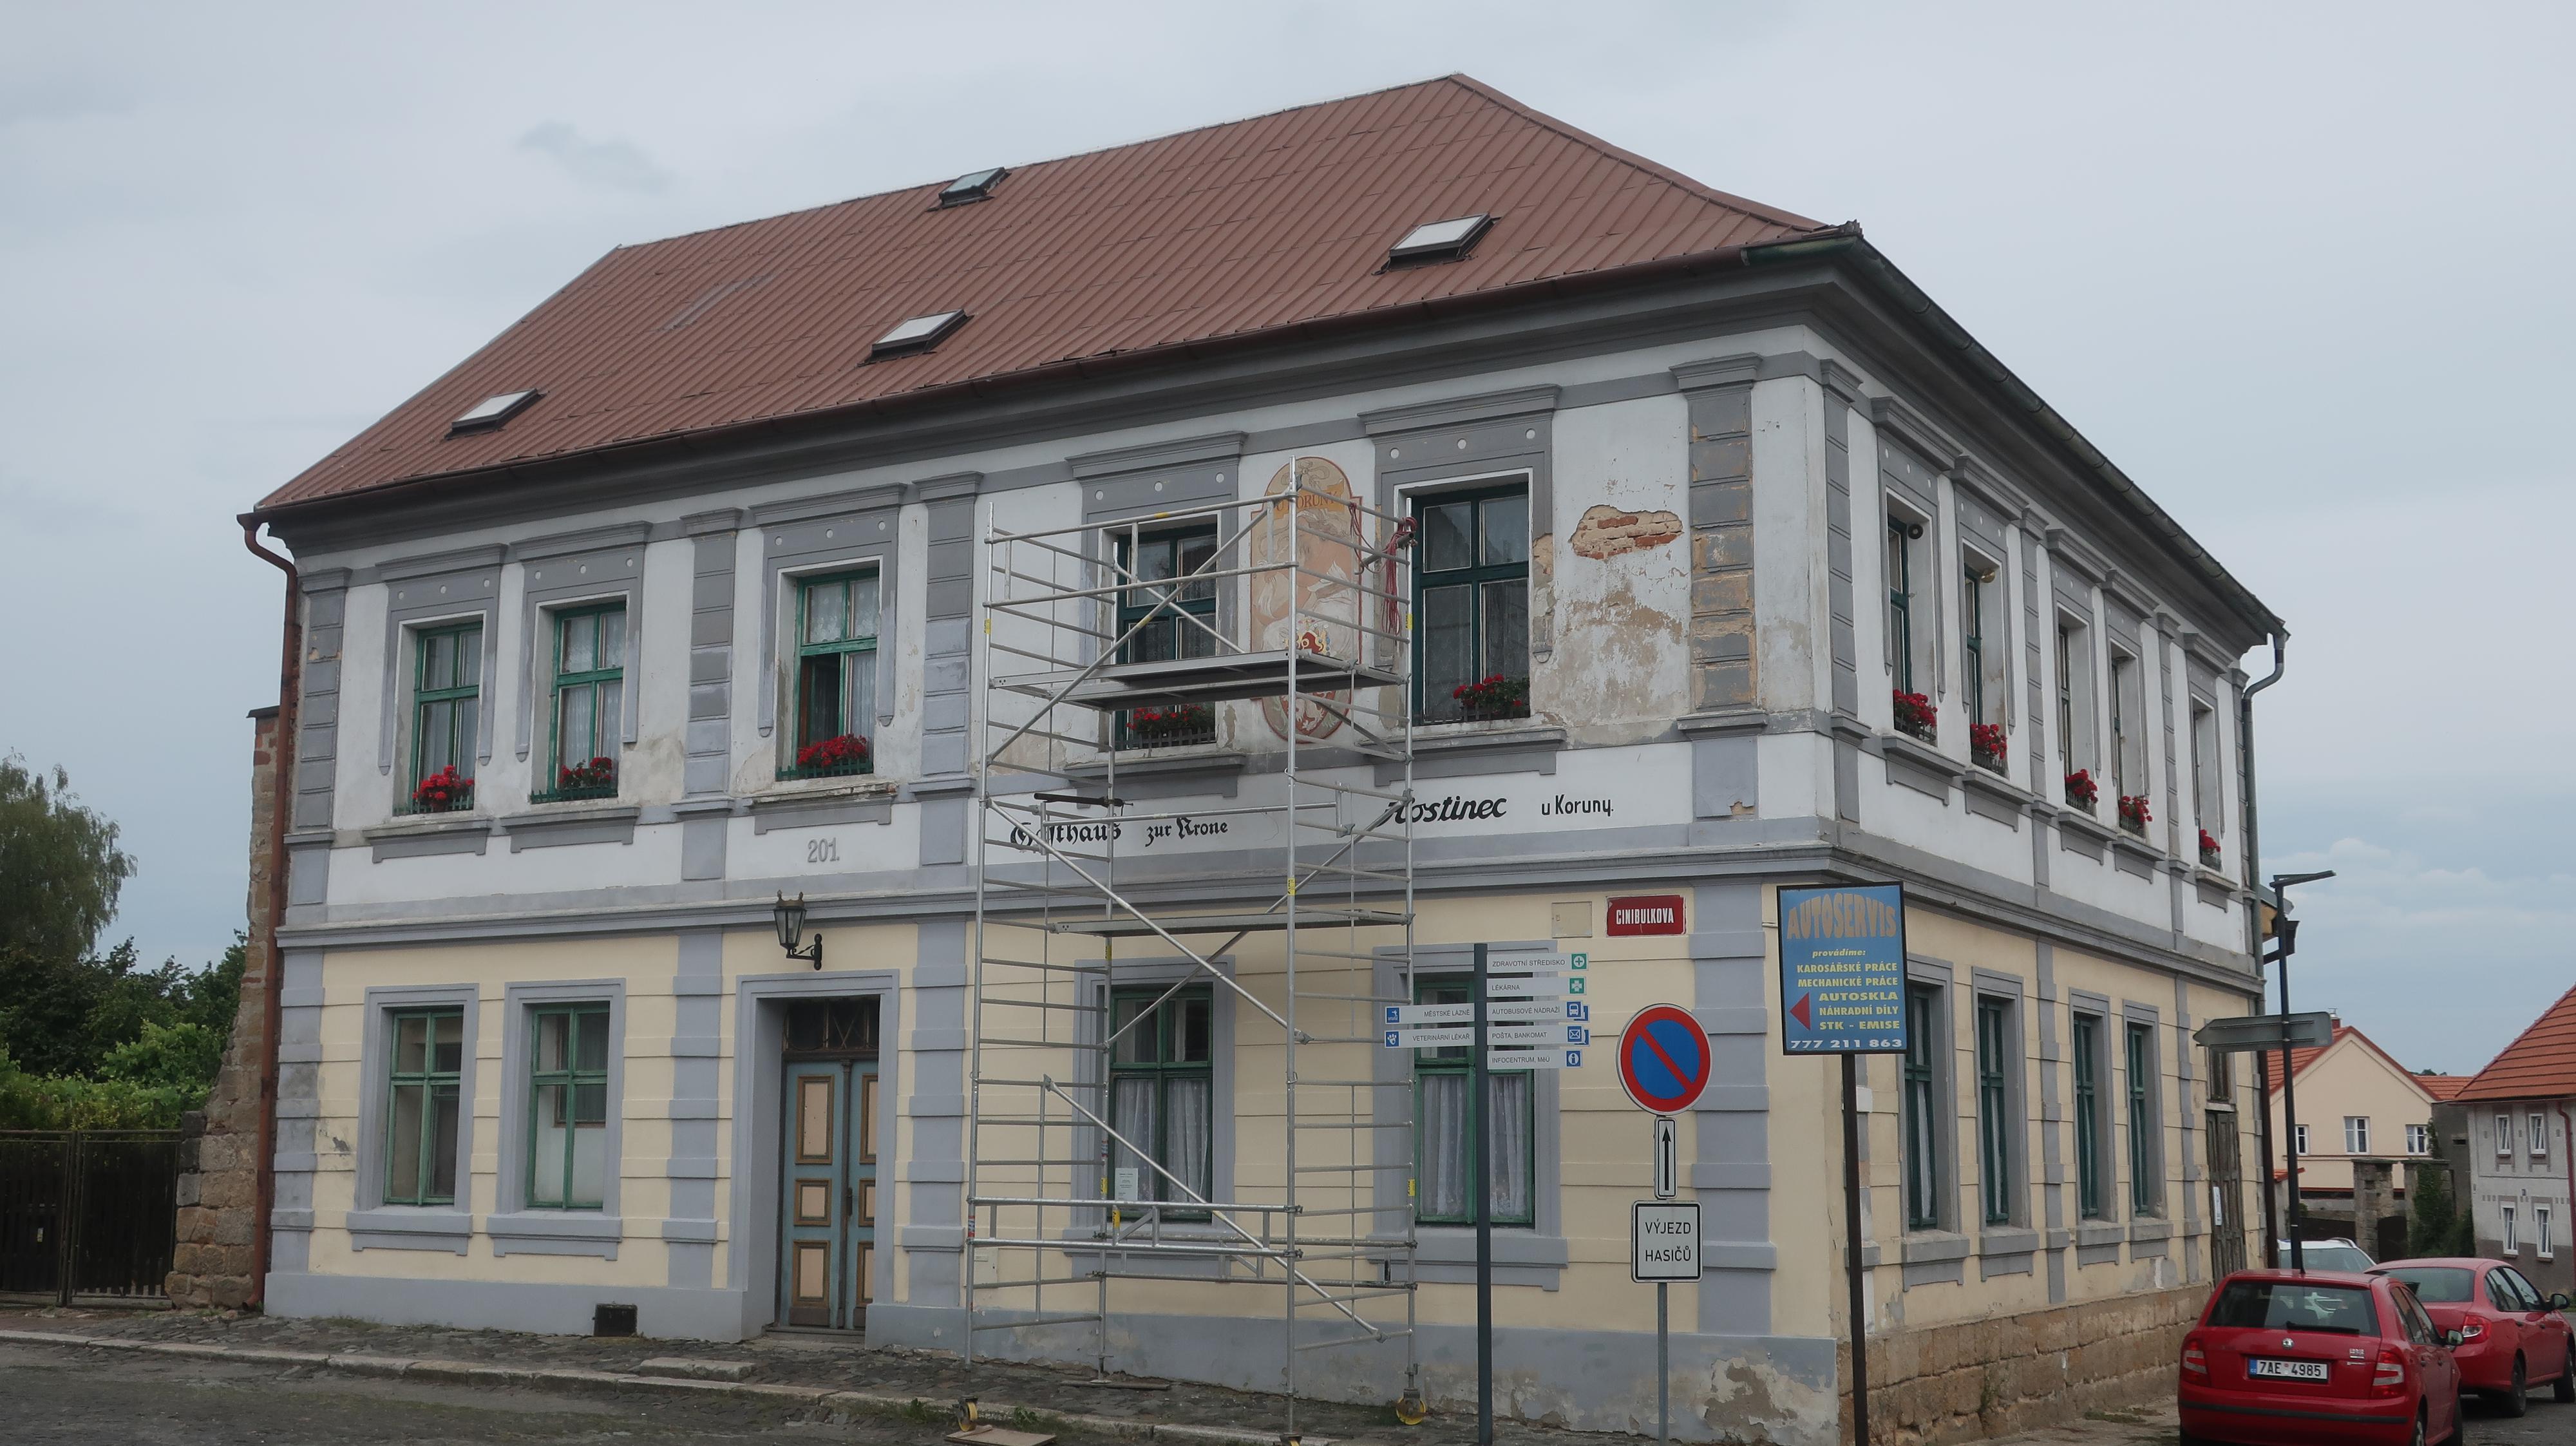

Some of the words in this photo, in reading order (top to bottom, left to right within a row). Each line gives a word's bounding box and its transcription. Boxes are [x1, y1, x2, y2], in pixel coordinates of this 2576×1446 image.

[1296, 491, 1337, 509] ORUNY
[1542, 803, 1550, 815] u
[1556, 794, 1614, 817] Koruny.
[1145, 825, 1171, 847] zur
[1177, 817, 1228, 839] Krone
[1616, 908, 1674, 924] CINIBULKOVA
[1786, 893, 1897, 939] AUTOSERVIS
[1812, 948, 1866, 958] provádíme:
[1797, 962, 1861, 973] KAROSÁŘSKÉ
[1865, 960, 1897, 972] PRÁCE
[1798, 976, 1862, 987] MECHANICKÉ
[1866, 975, 1898, 986] PRÁCE
[1819, 992, 1899, 1001] AUTOSKLA
[1819, 1005, 1872, 1016] NÁHRADNÍ
[1876, 1004, 1899, 1015] DÍLY
[1820, 1022, 1844, 1030] STK
[1859, 1021, 1900, 1029] EMISE
[1790, 1040, 1823, 1049] 777
[1830, 1040, 1861, 1048] 211
[1869, 1039, 1902, 1047] 863
[1645, 1218, 1691, 1234] VÝJEZD
[1645, 1246, 1691, 1261] HASIČŮ
[2260, 1362, 2281, 1374] 7AE
[2291, 1364, 2321, 1376] 4985
